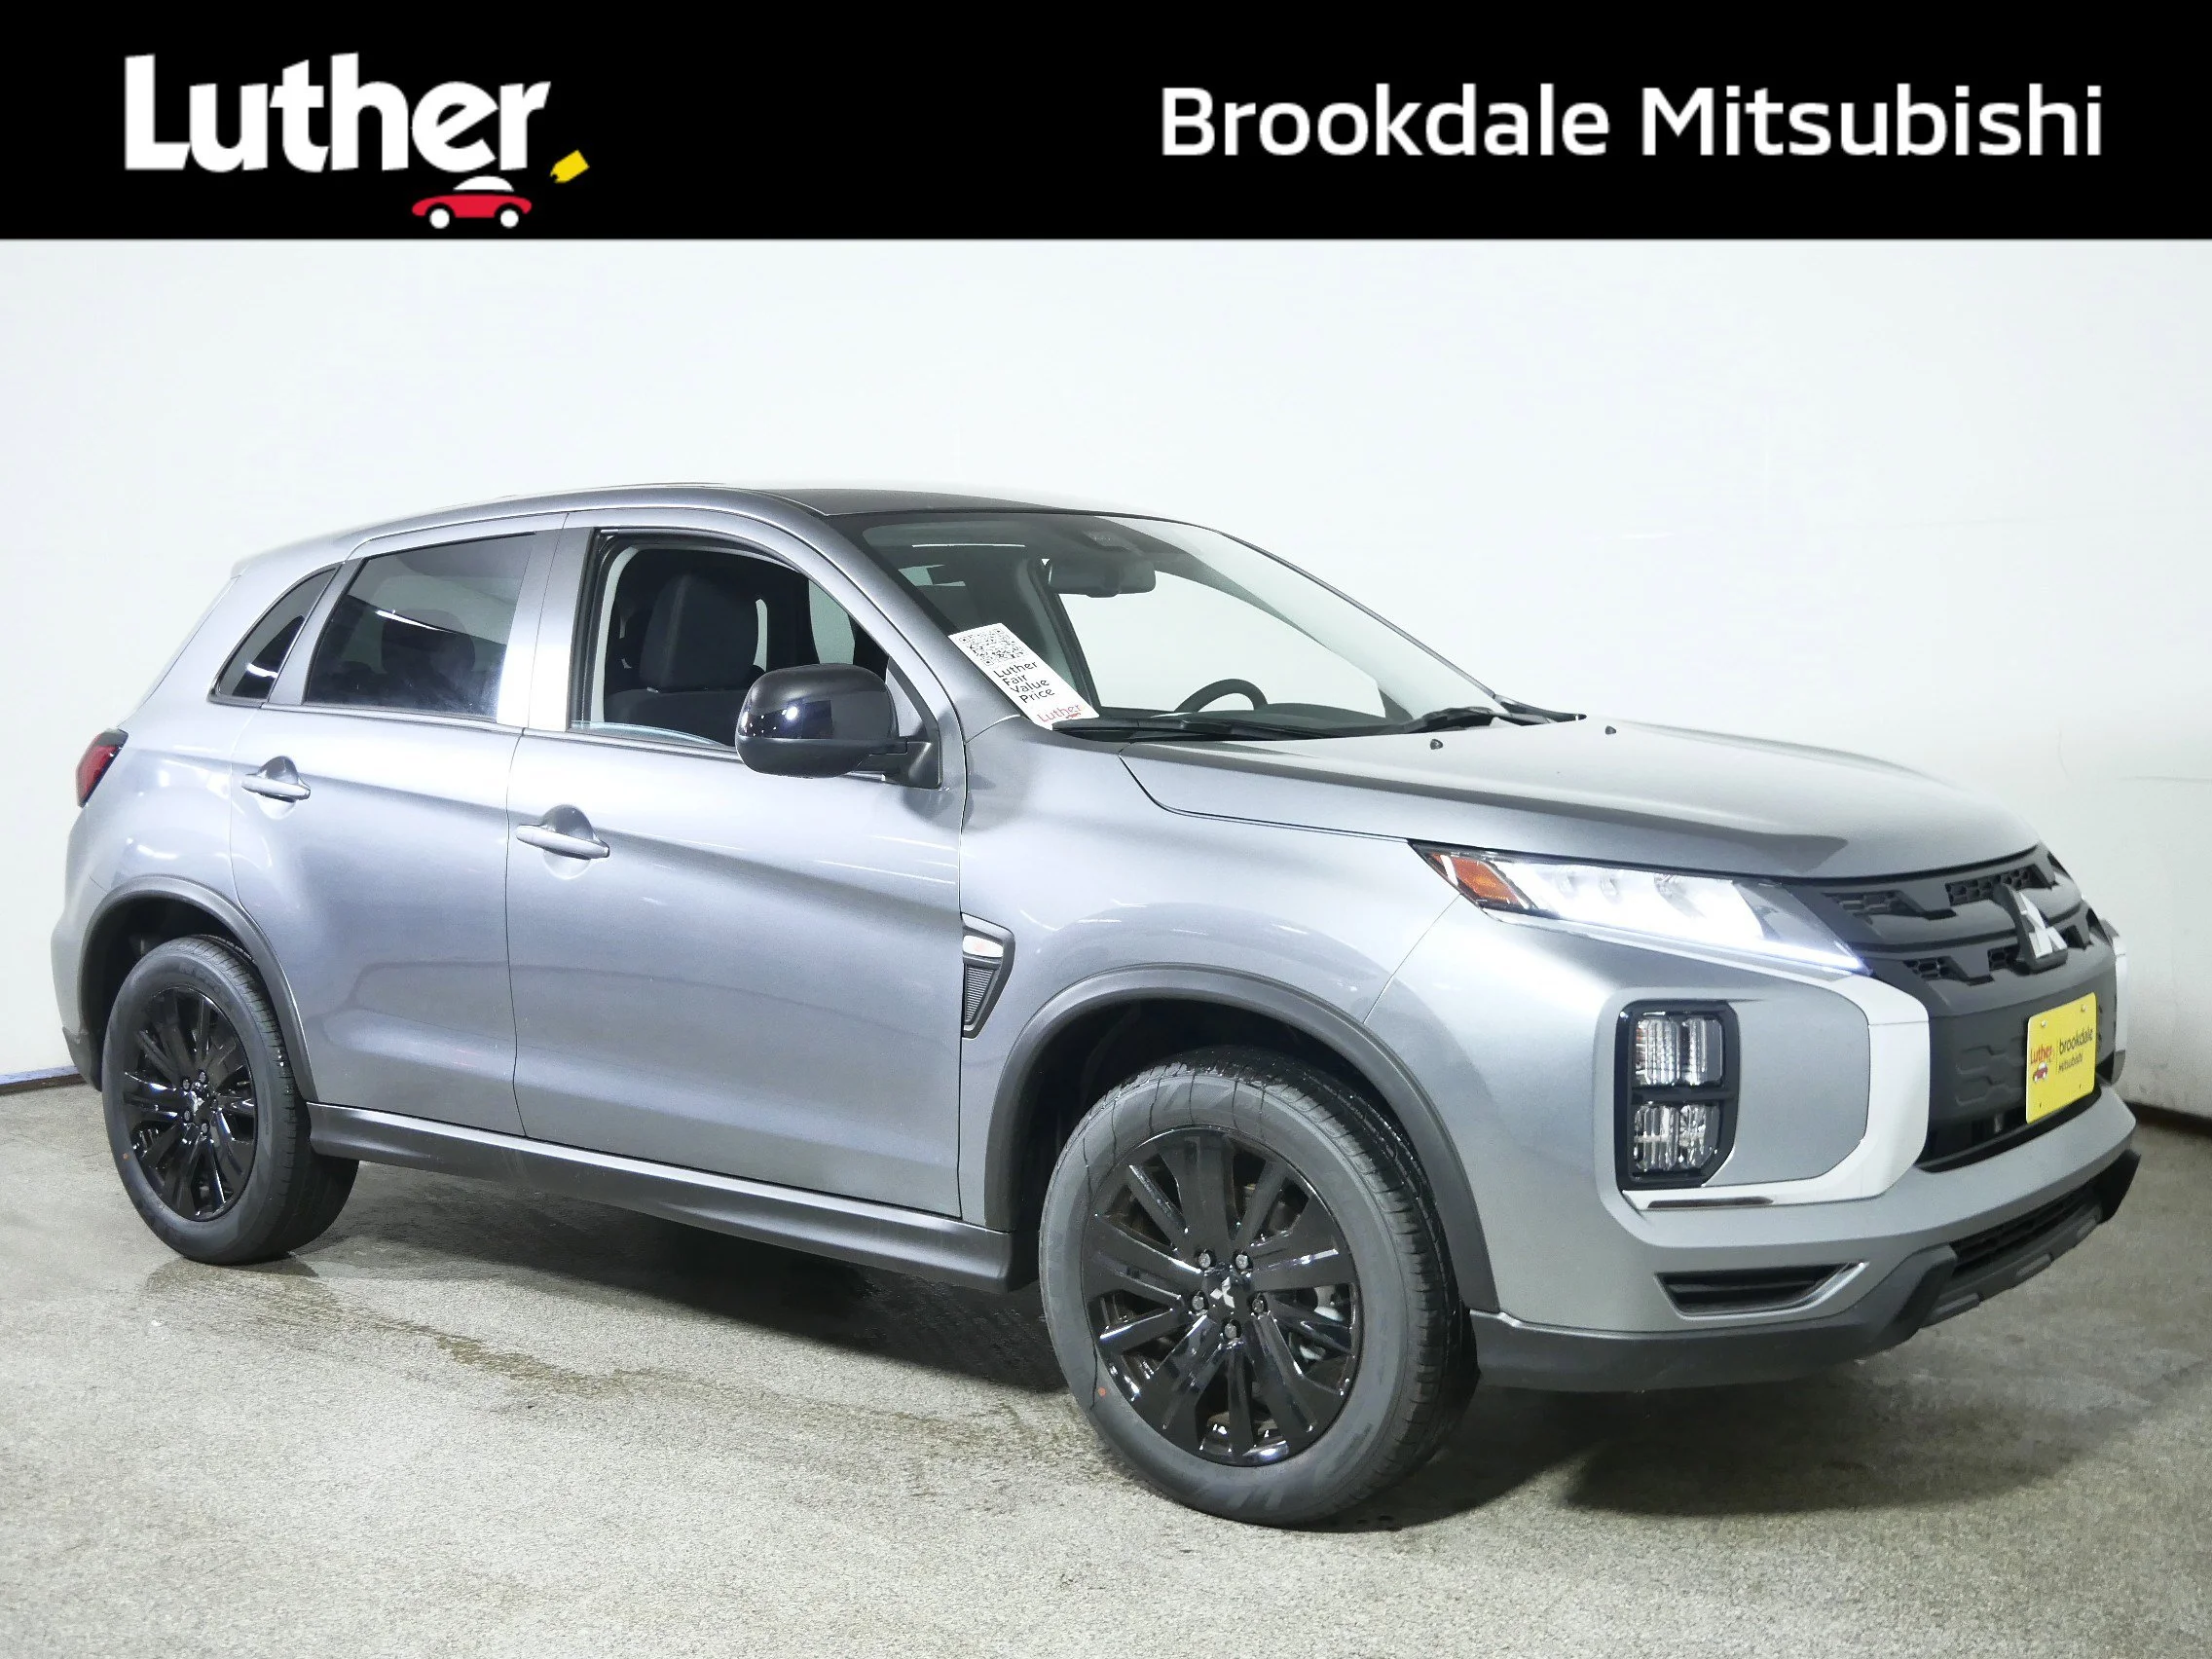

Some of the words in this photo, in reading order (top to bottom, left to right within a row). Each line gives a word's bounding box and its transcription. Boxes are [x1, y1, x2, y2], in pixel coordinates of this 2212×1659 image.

[993, 661, 1038, 679] Luther
[1002, 674, 1028, 686] Fair
[1010, 679, 1050, 693] Value
[1018, 687, 1055, 704] Price
[1037, 704, 1082, 722] Luther
[2059, 1025, 2093, 1054] brookdale
[2030, 1044, 2052, 1064] Luther
